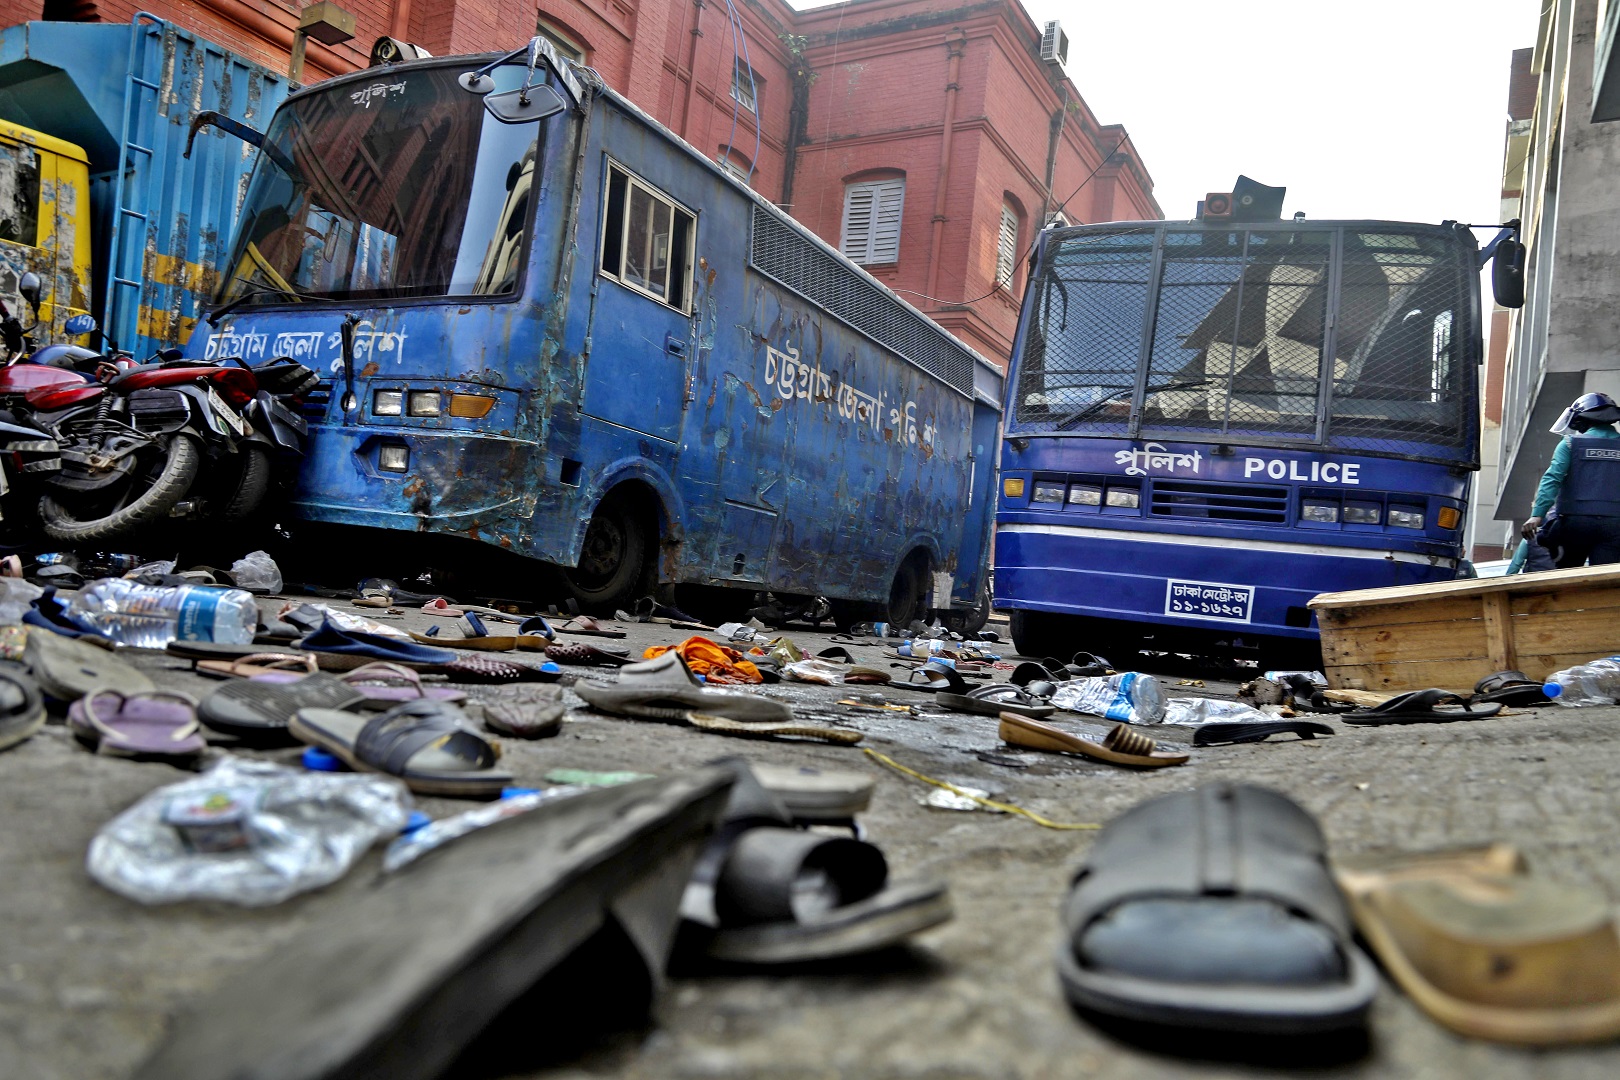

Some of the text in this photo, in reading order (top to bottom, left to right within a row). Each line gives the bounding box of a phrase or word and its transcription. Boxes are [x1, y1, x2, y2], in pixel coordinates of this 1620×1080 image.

[272, 331, 325, 359] জেলা
[838, 381, 886, 433] জেলা
[1114, 442, 1203, 476] পুলিশ
[1244, 457, 1361, 485] POLICE
[1173, 585, 1202, 599] ঢাকা
[1173, 600, 1243, 616] ১১-১৬২৭
